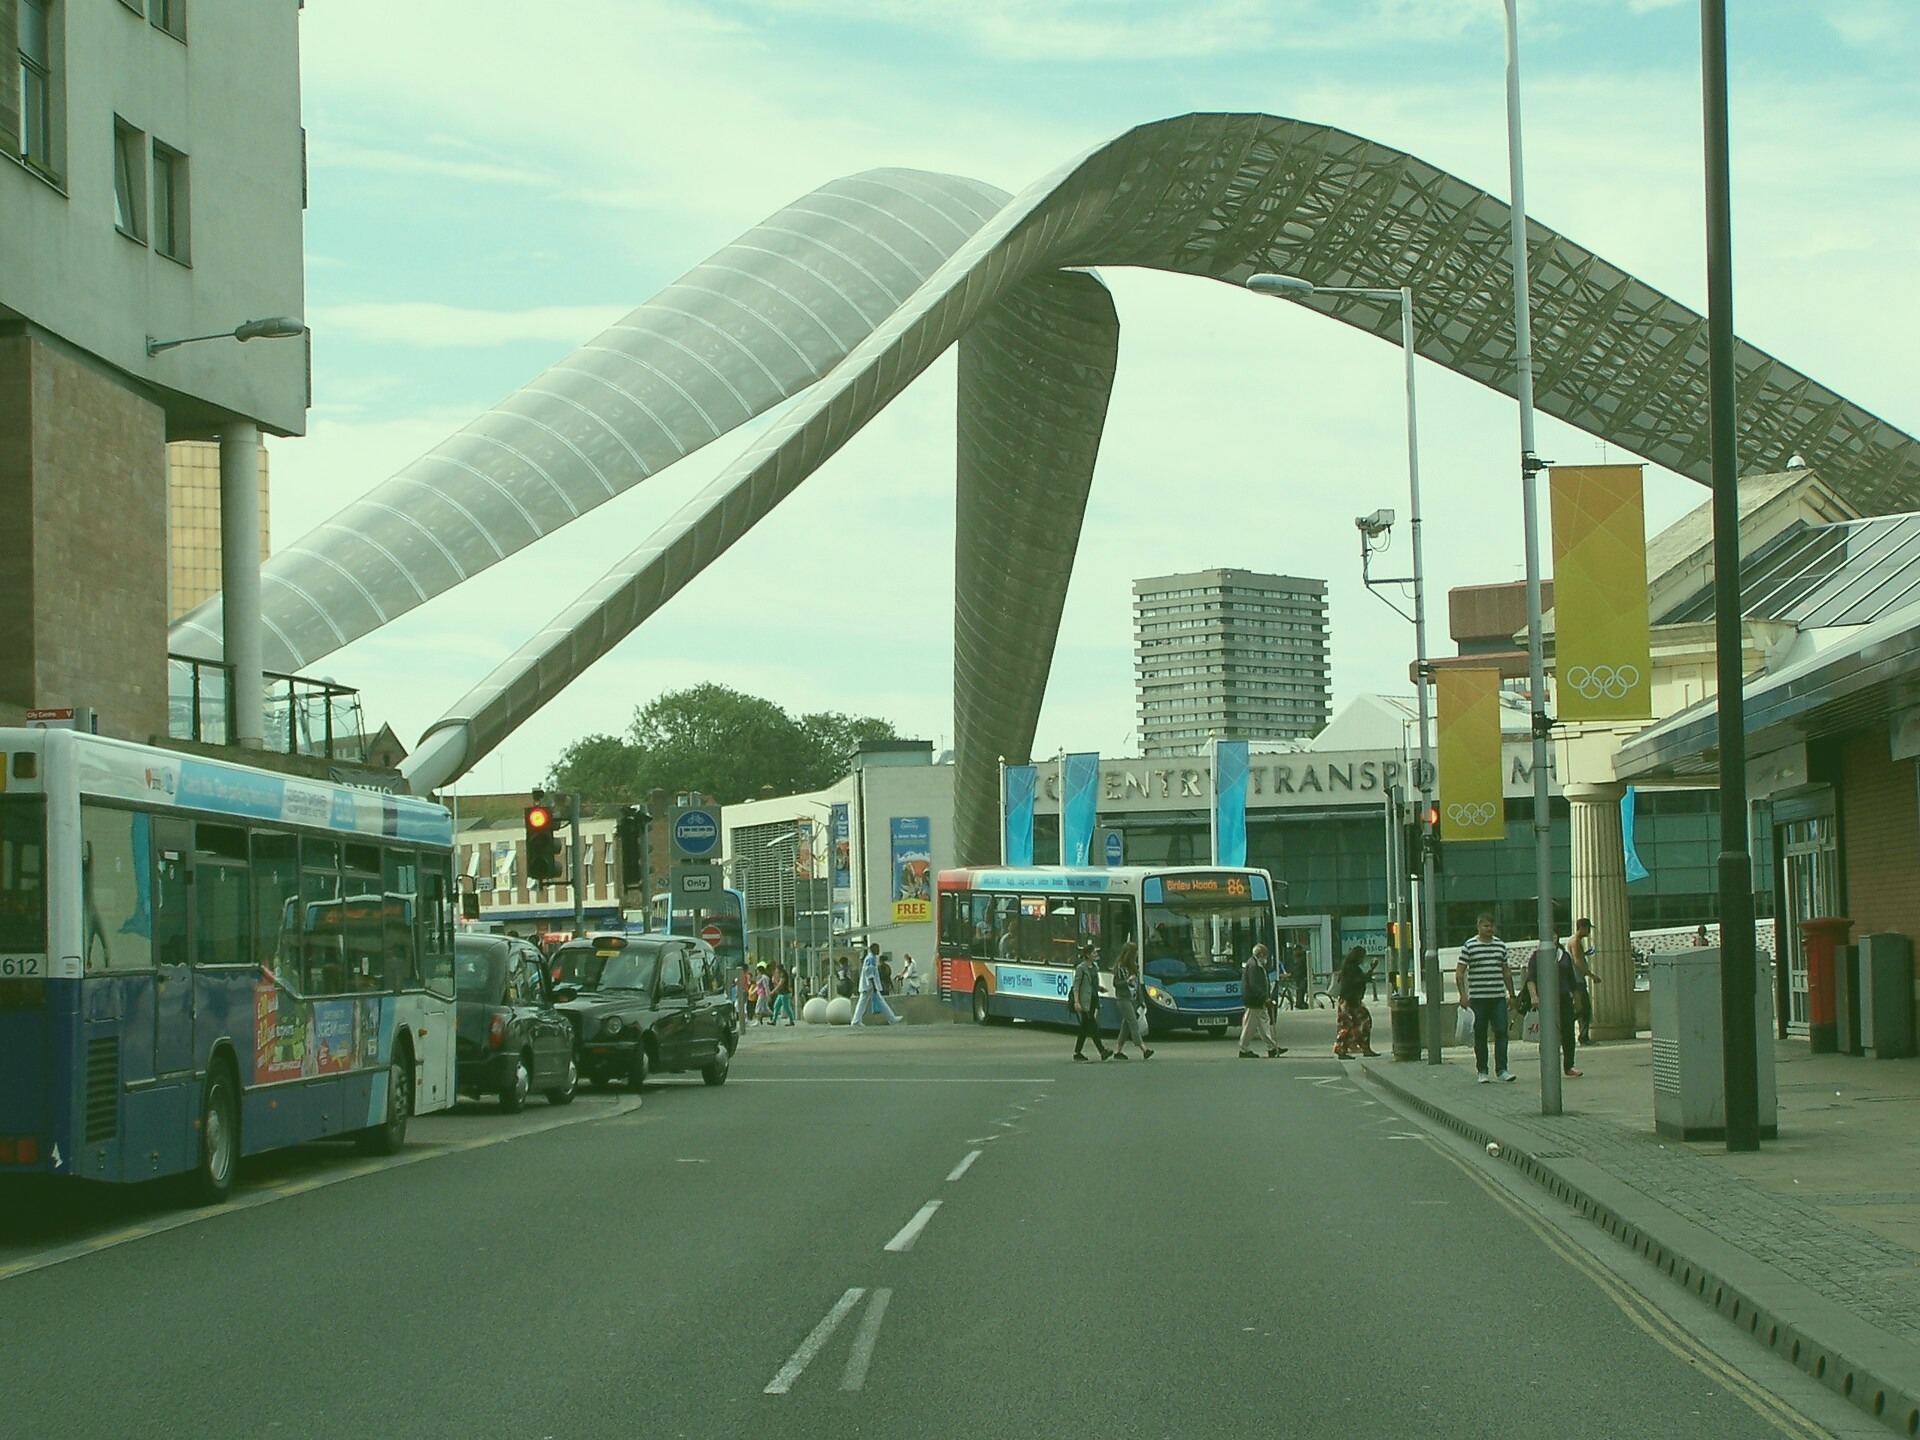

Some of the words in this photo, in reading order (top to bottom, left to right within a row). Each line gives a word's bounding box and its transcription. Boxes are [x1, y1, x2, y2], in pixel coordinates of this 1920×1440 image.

[686, 879, 707, 888] Only
[1166, 880, 1191, 891] Binley
[1192, 879, 1218, 890] Woods
[1227, 878, 1245, 895] 86
[897, 903, 926, 915] FREE
[0, 958, 39, 975] 612
[1016, 974, 1022, 986] 15
[1057, 974, 1068, 996] 86
[1225, 983, 1239, 993] 86
